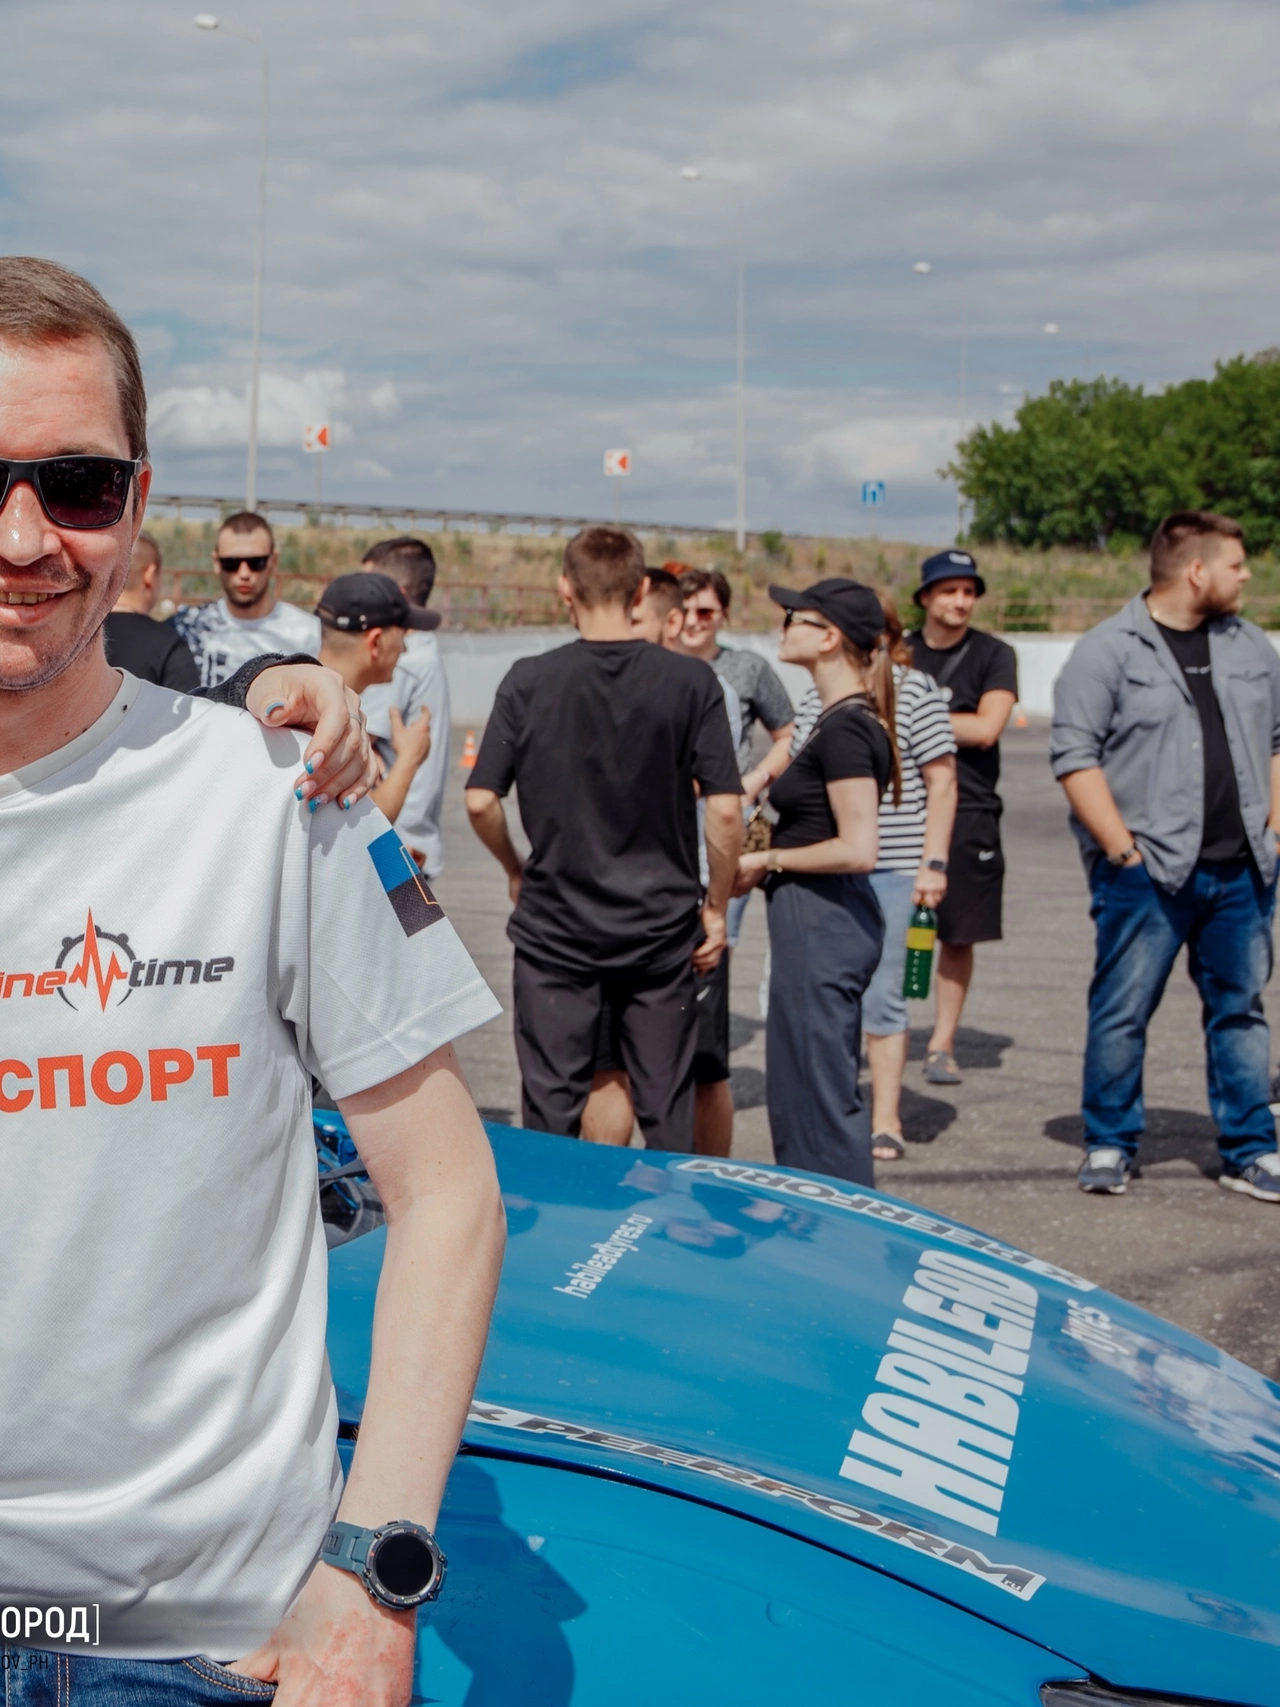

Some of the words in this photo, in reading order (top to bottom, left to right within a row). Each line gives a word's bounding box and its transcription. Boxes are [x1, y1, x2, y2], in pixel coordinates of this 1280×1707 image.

[129, 955, 235, 988] time
[552, 1213, 654, 1299] habileadtyres.ru
[839, 1249, 1039, 1536] HABILEAD
[515, 1417, 1036, 1593] PEERFORM
